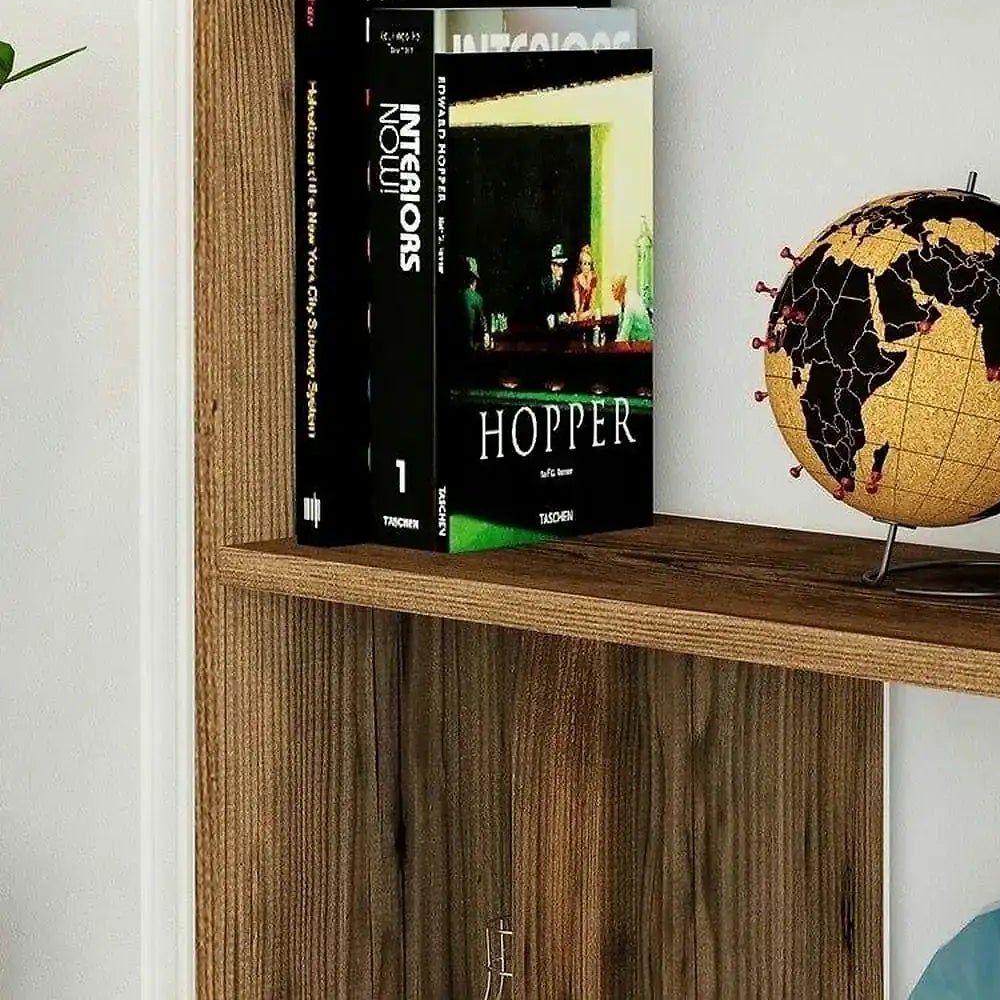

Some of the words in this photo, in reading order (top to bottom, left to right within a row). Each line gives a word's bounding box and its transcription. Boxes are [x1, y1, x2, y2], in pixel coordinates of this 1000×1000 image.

[437, 76, 447, 139] EDWARD
[399, 103, 421, 273] INTERIORS
[437, 143, 447, 203] HOPPER
[306, 211, 318, 244] New
[478, 396, 637, 461] HOPPER
[395, 459, 406, 493] 1
[383, 515, 419, 530] TASCHEN
[437, 486, 448, 537] TASCHEN
[539, 509, 575, 526] TASCHEN
